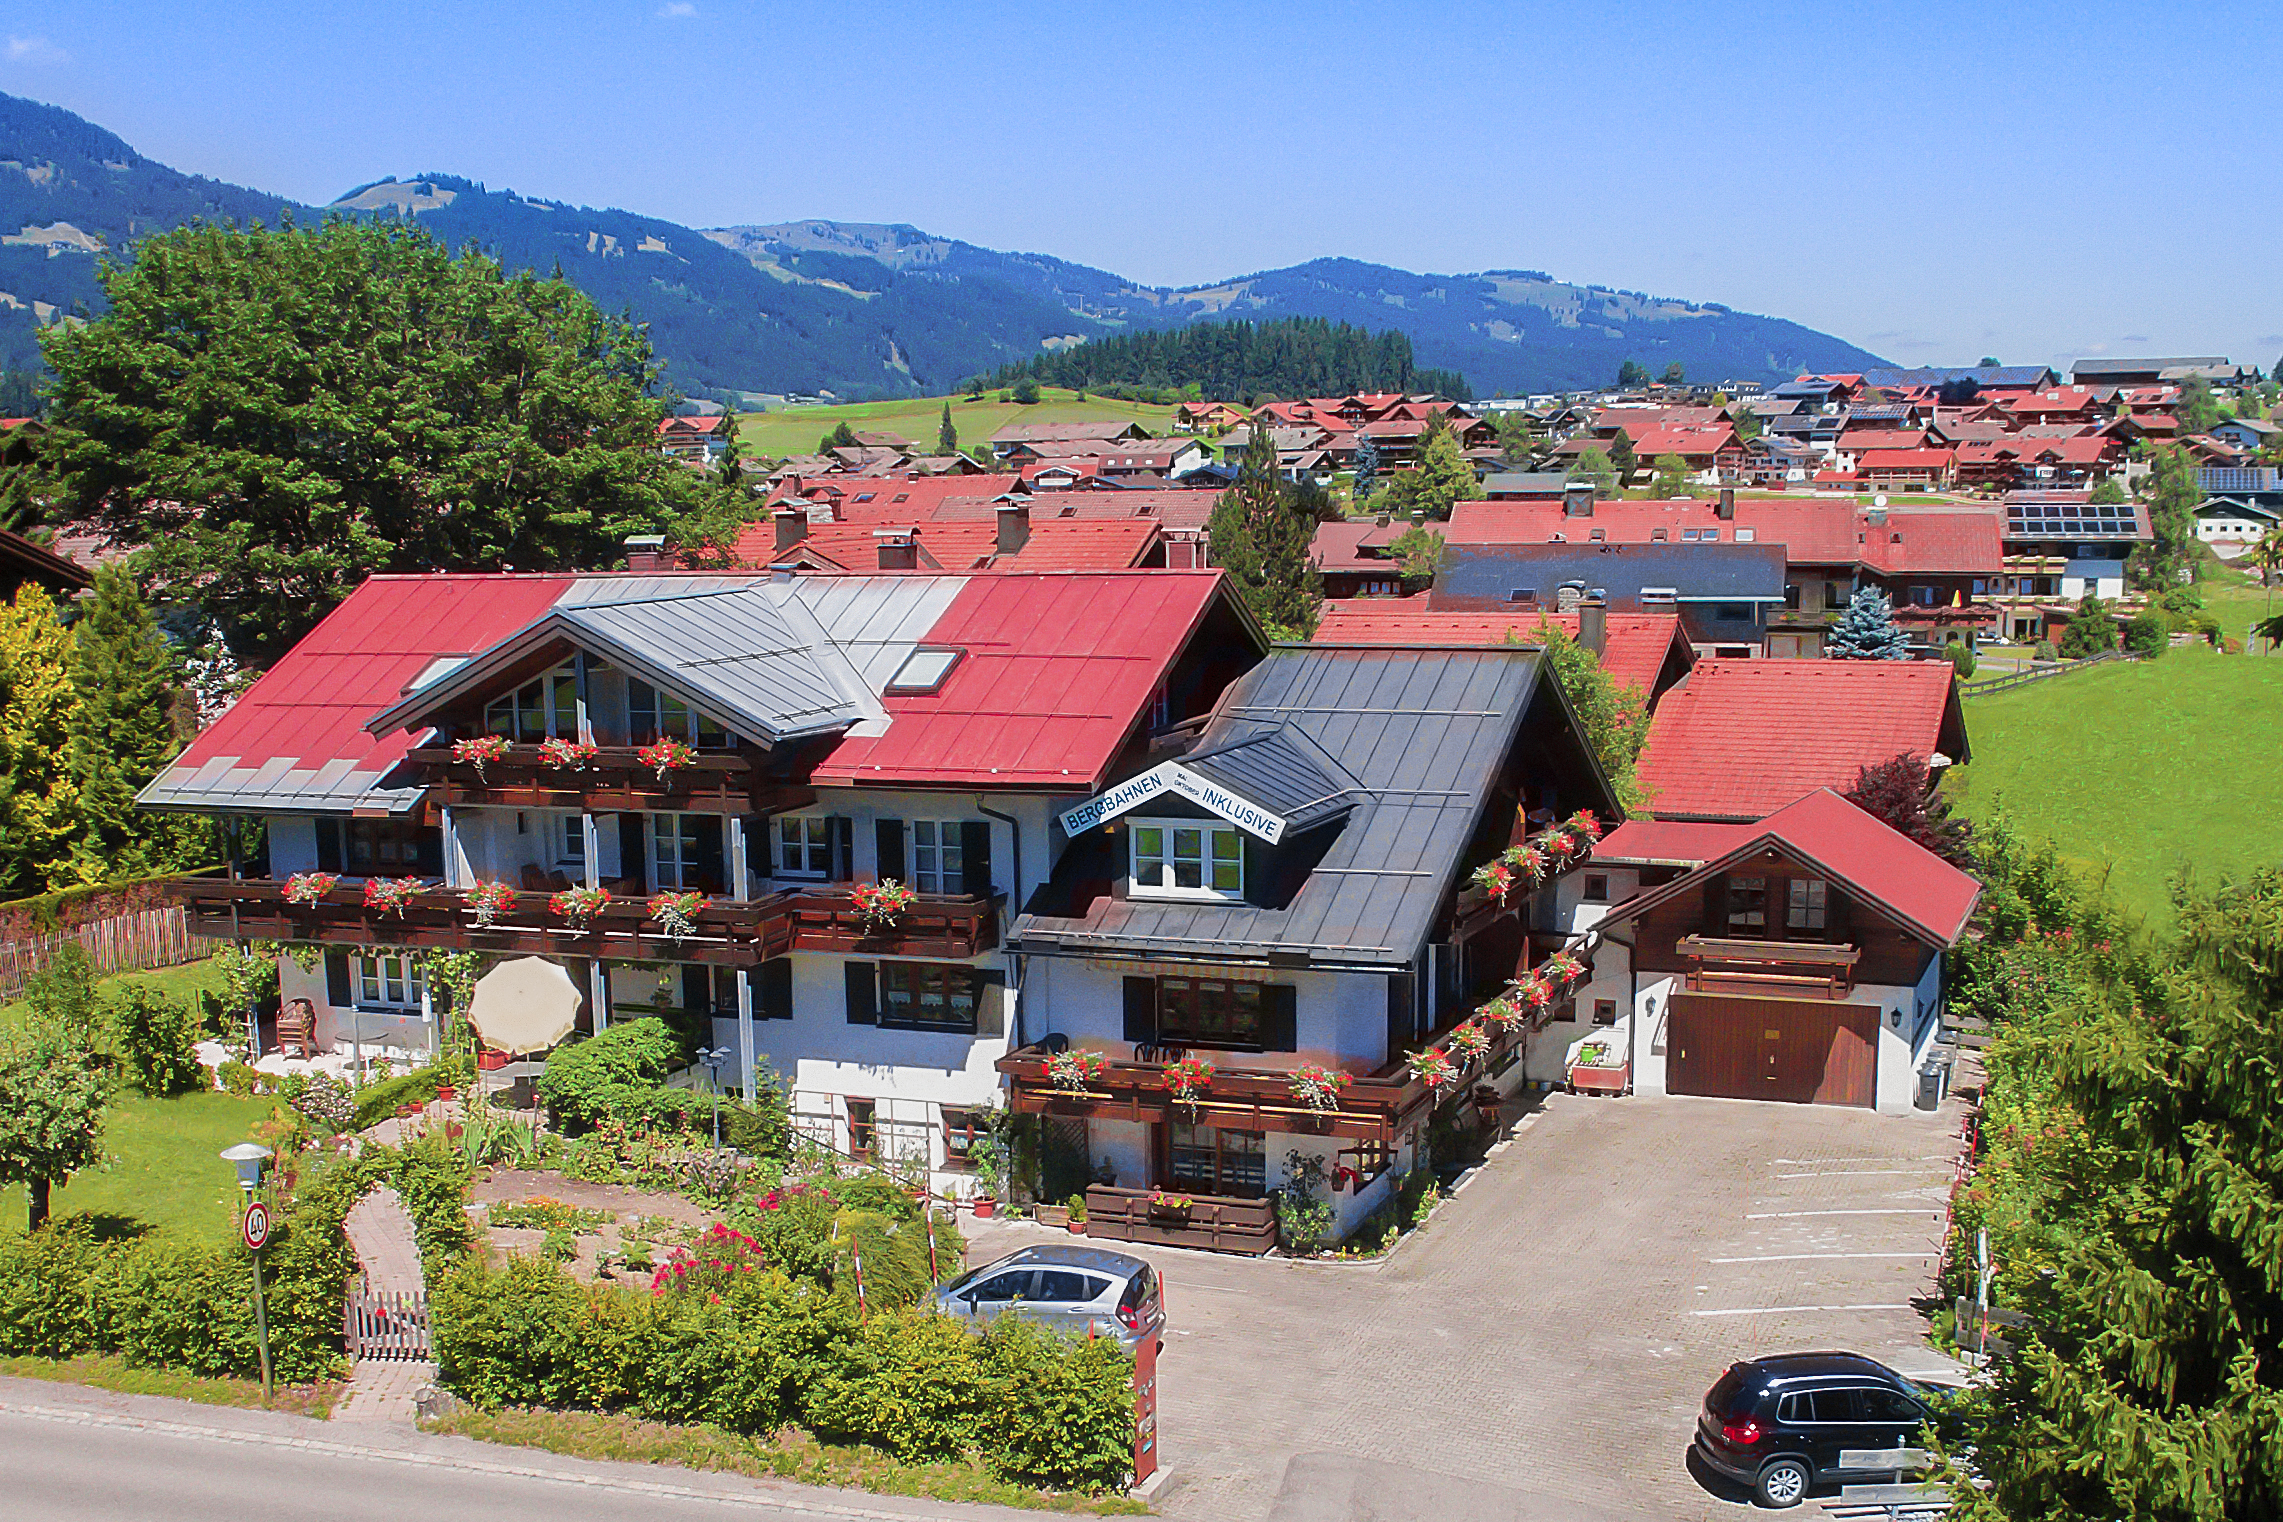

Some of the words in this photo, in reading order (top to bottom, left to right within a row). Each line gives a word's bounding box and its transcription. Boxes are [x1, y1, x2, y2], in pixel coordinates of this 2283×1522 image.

[1067, 773, 1163, 830] BERGBAHNEN
[1202, 787, 1277, 836] INKLUSIVE
[250, 1213, 264, 1235] 40
